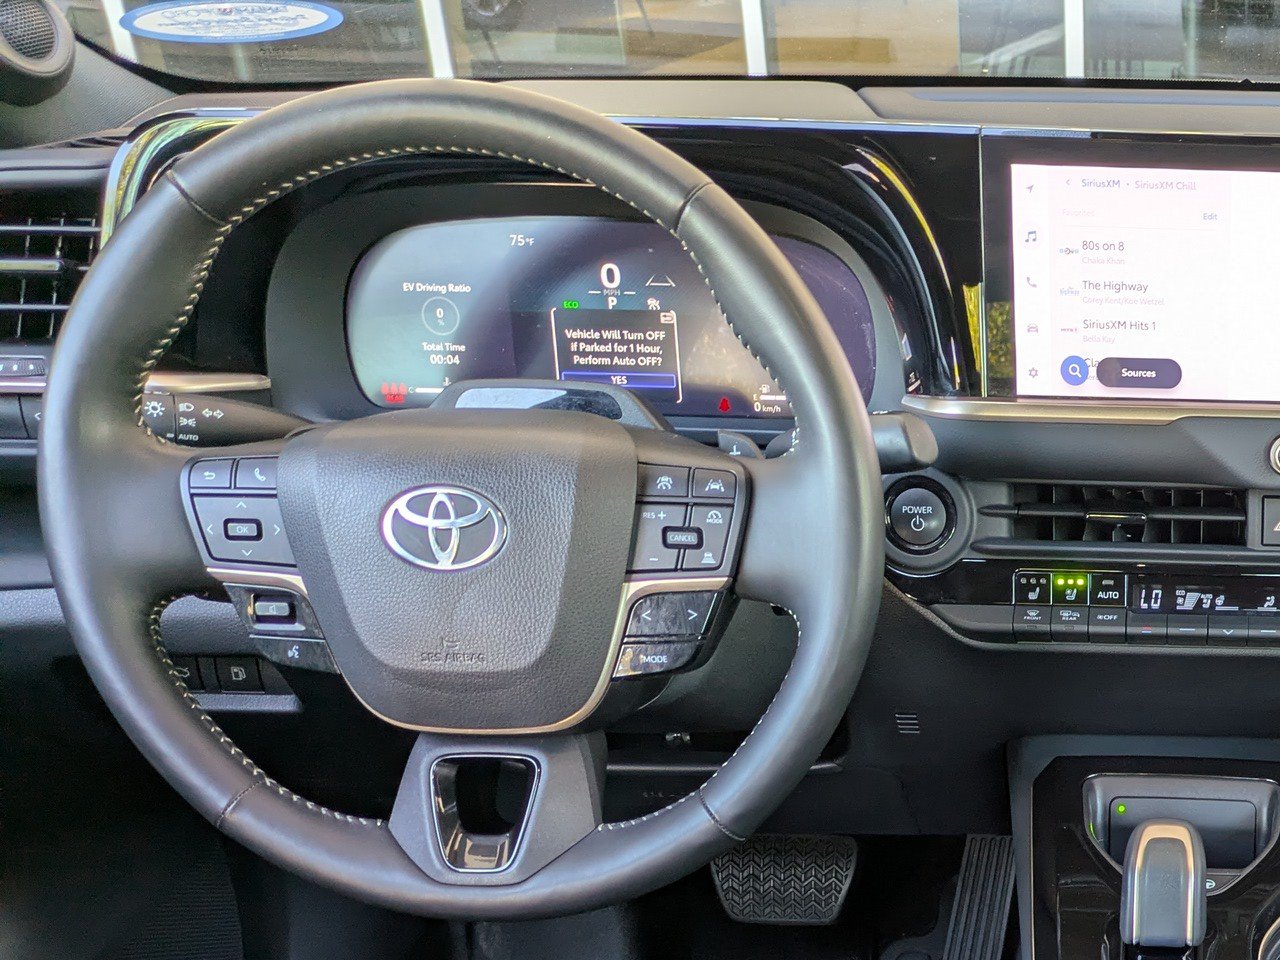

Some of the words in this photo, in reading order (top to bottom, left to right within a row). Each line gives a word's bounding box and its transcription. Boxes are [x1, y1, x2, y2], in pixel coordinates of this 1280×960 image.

[1081, 179, 1121, 189] SiriusXM
[1135, 180, 1174, 190] SiriusXM
[1175, 181, 1197, 191] Chill
[1202, 212, 1218, 221] Edit
[1081, 240, 1100, 251] 80s
[1102, 243, 1116, 251] on
[1117, 241, 1125, 251] 8
[600, 263, 621, 289] 0
[402, 282, 414, 292] EV
[416, 283, 447, 294] Driving
[448, 284, 472, 293] Ratio
[1082, 280, 1101, 291] The
[1103, 282, 1149, 294] Highway
[608, 296, 618, 310] P
[436, 308, 444, 318] 0
[1082, 319, 1127, 330] SiriusXM
[1129, 320, 1149, 331] Hits
[1151, 321, 1157, 331] 1
[565, 329, 601, 339] Vehicle
[602, 330, 622, 340] Will
[622, 331, 644, 340] Turn
[645, 331, 666, 341] OFF
[422, 342, 444, 351] Total
[444, 342, 466, 352] Time
[579, 342, 612, 353] Parked
[613, 342, 627, 353] for
[629, 343, 635, 353] 1
[636, 343, 663, 355] Hour,
[429, 355, 460, 365] 00:04
[573, 355, 611, 365] Perform
[612, 356, 636, 366] Auto
[637, 357, 663, 366] OFF?
[1121, 368, 1156, 378] Sources
[611, 376, 628, 385] YES
[753, 402, 762, 412] 0
[762, 405, 781, 414] km/h
[178, 433, 199, 441] AUTO
[902, 505, 933, 514] POWER
[642, 511, 656, 519] RES
[236, 526, 248, 534] OK
[669, 533, 696, 542] CANCEL
[1097, 591, 1119, 599] AUTO
[1140, 589, 1162, 609] LO
[643, 655, 668, 664] MODE
